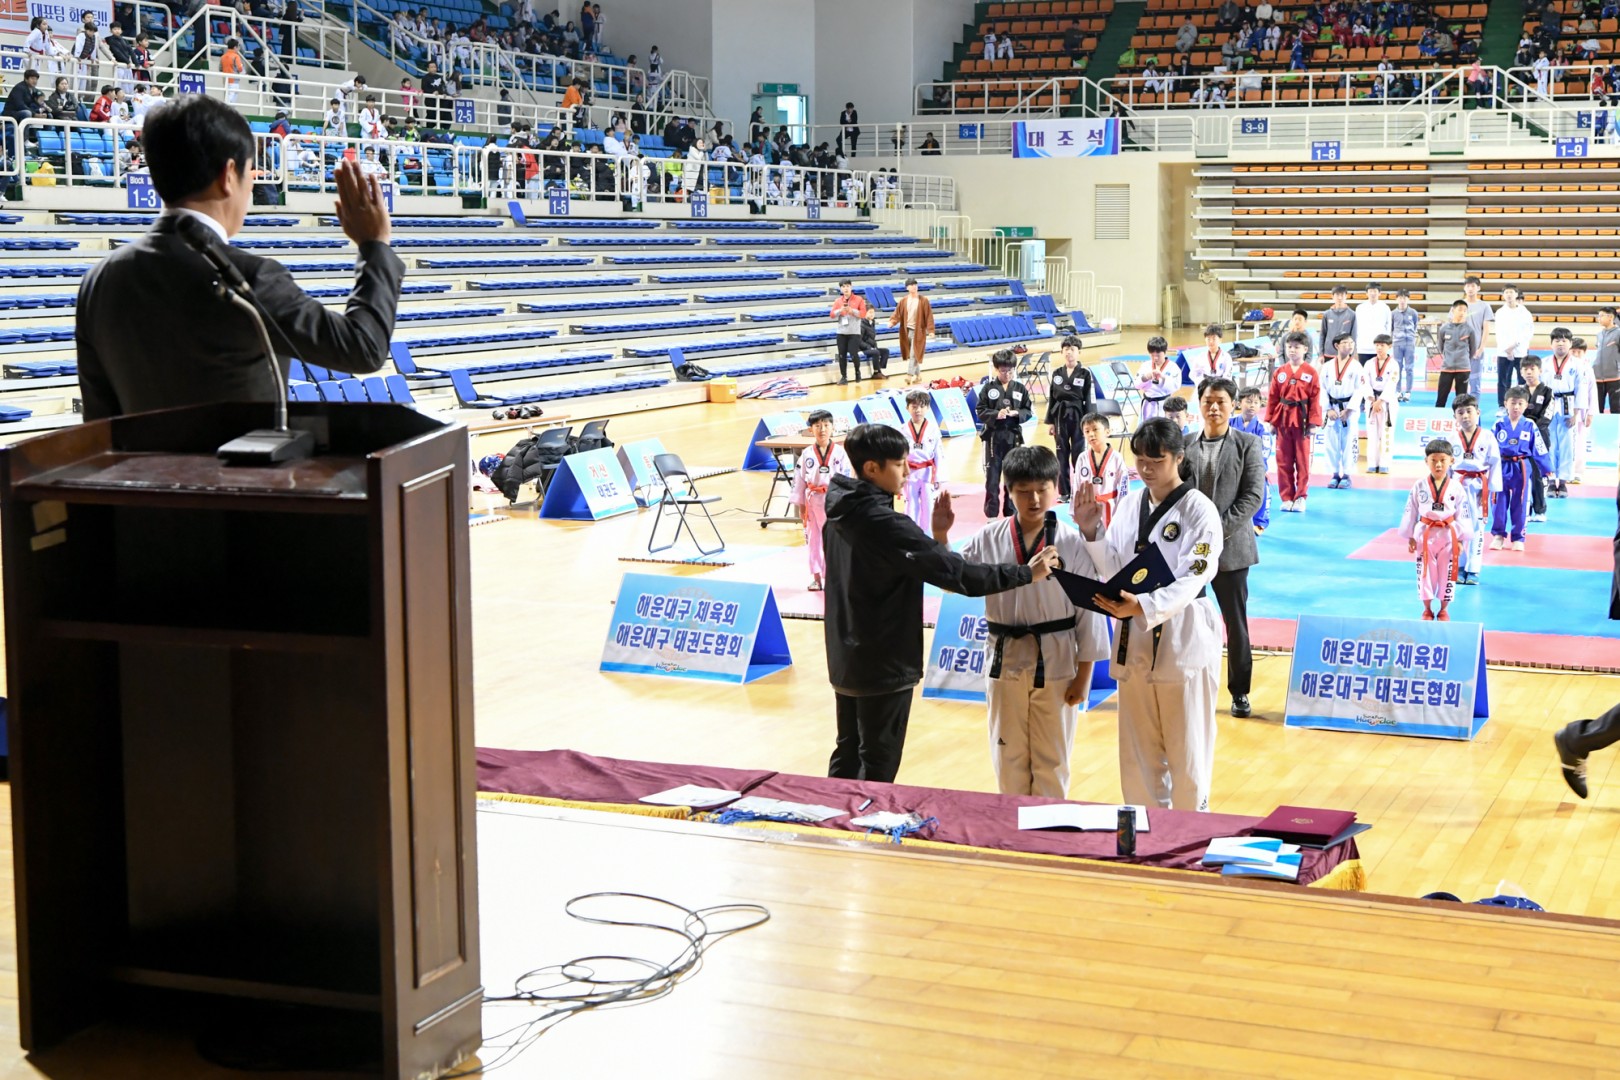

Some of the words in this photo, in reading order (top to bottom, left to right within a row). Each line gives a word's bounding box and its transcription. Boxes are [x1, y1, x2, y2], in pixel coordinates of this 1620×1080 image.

[31, 3, 65, 22] 대표팀
[69, 6, 108, 26] 화팅!!
[457, 109, 473, 122] 2-5
[1245, 122, 1264, 133] 3-9
[1315, 149, 1337, 160] 1-8
[1560, 144, 1583, 157] 1-9
[132, 188, 157, 208] 1-3
[552, 200, 567, 214] 1-5
[694, 204, 706, 217] 1-6
[808, 207, 819, 218] 1-7
[636, 594, 692, 620] 해운대구
[694, 600, 739, 626] 체육회
[616, 624, 671, 650] 해운대구
[673, 630, 743, 658] 태권도협회
[938, 647, 985, 674] 해운대
[1321, 639, 1389, 667] 해운대구
[1395, 643, 1449, 671] 체육회
[1301, 672, 1369, 701] 해운대구
[1375, 678, 1462, 708] 태권도협회
